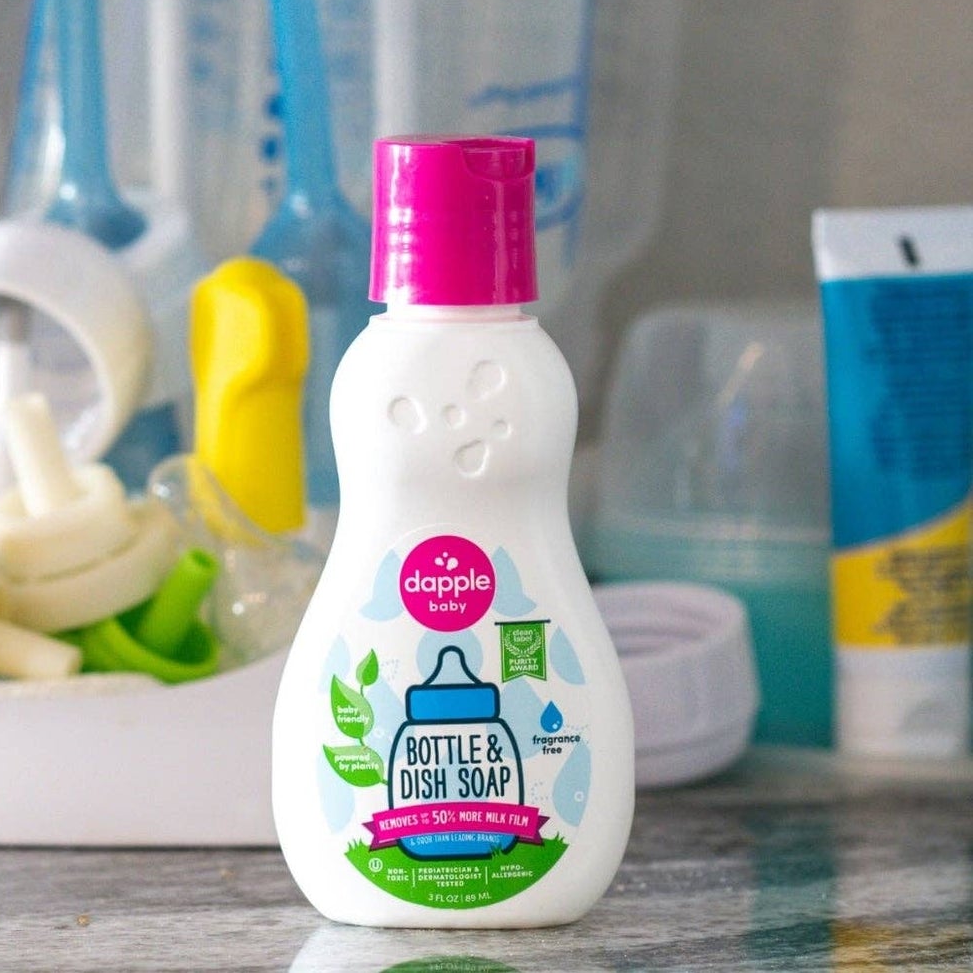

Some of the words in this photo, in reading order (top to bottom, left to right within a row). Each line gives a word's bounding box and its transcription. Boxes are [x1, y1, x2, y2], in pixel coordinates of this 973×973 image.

[404, 568, 491, 598] dapple
[429, 600, 467, 614] baby
[509, 664, 539, 672] AWARD
[337, 705, 359, 715] baby
[337, 714, 370, 725] friendly
[532, 735, 581, 746] fragrance
[406, 735, 481, 766] BOTTLE
[487, 734, 504, 763] &
[542, 745, 563, 755] free
[334, 753, 371, 763] powered
[339, 762, 351, 772] by
[351, 762, 380, 772] plants
[401, 768, 447, 800] DISH
[458, 766, 511, 799] SOAP
[379, 815, 418, 831] REMOVES
[433, 810, 457, 826] 50%
[459, 811, 483, 823] MORE
[485, 811, 506, 824] MILK
[508, 813, 529, 827] FILM
[417, 834, 433, 845] ODOR
[435, 833, 450, 843] THAN
[451, 833, 475, 842] LEADING
[418, 867, 472, 875] PEDIATRICIAN
[492, 870, 534, 879] ALLERGENIC
[387, 874, 409, 882] TOXIC
[418, 873, 483, 881] DERMATOLOGIST
[428, 893, 434, 902] 3
[435, 894, 445, 902] FL
[446, 894, 459, 903] OZ
[465, 893, 476, 902] 89
[478, 891, 492, 901] ML
